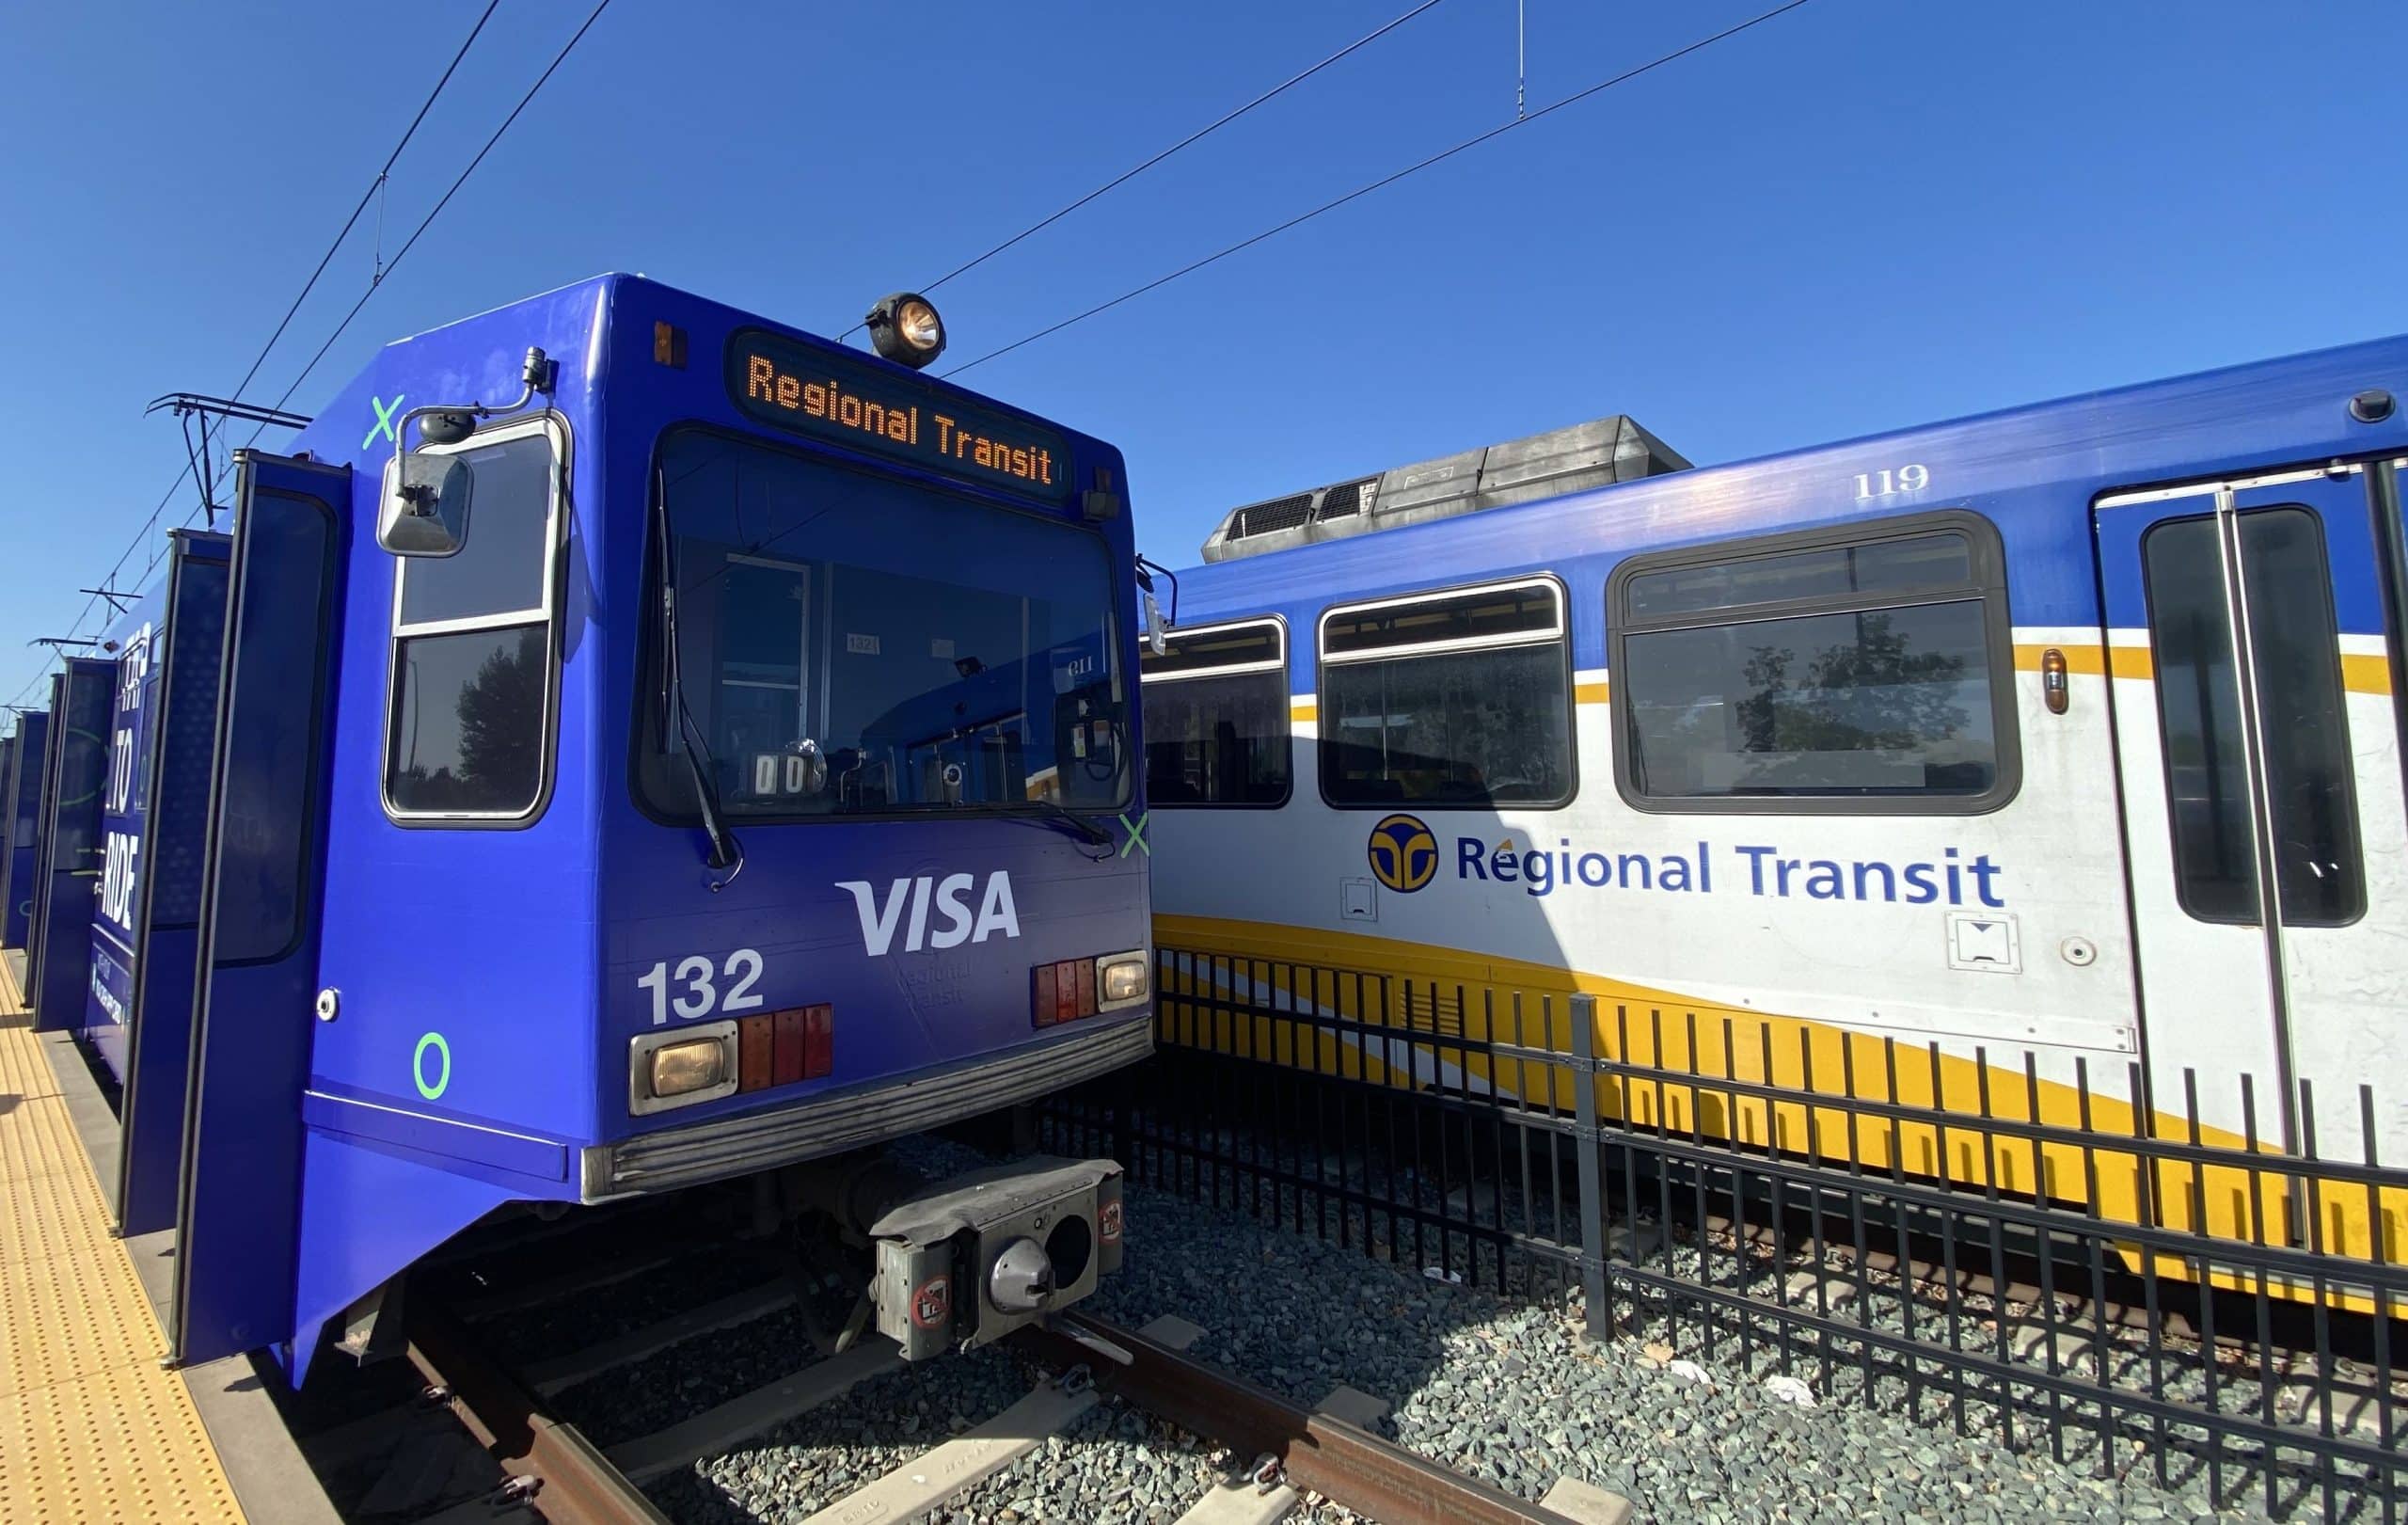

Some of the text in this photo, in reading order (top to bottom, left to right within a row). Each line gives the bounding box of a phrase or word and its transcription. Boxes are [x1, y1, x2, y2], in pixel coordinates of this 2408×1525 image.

[748, 354, 1052, 485] Regional Transit
[1853, 464, 1929, 500] 119
[113, 727, 133, 813] TO
[102, 832, 139, 930] RIDE
[834, 870, 1022, 957] VISA
[1457, 836, 2005, 908] Regional Transit
[638, 948, 764, 1025] 132
